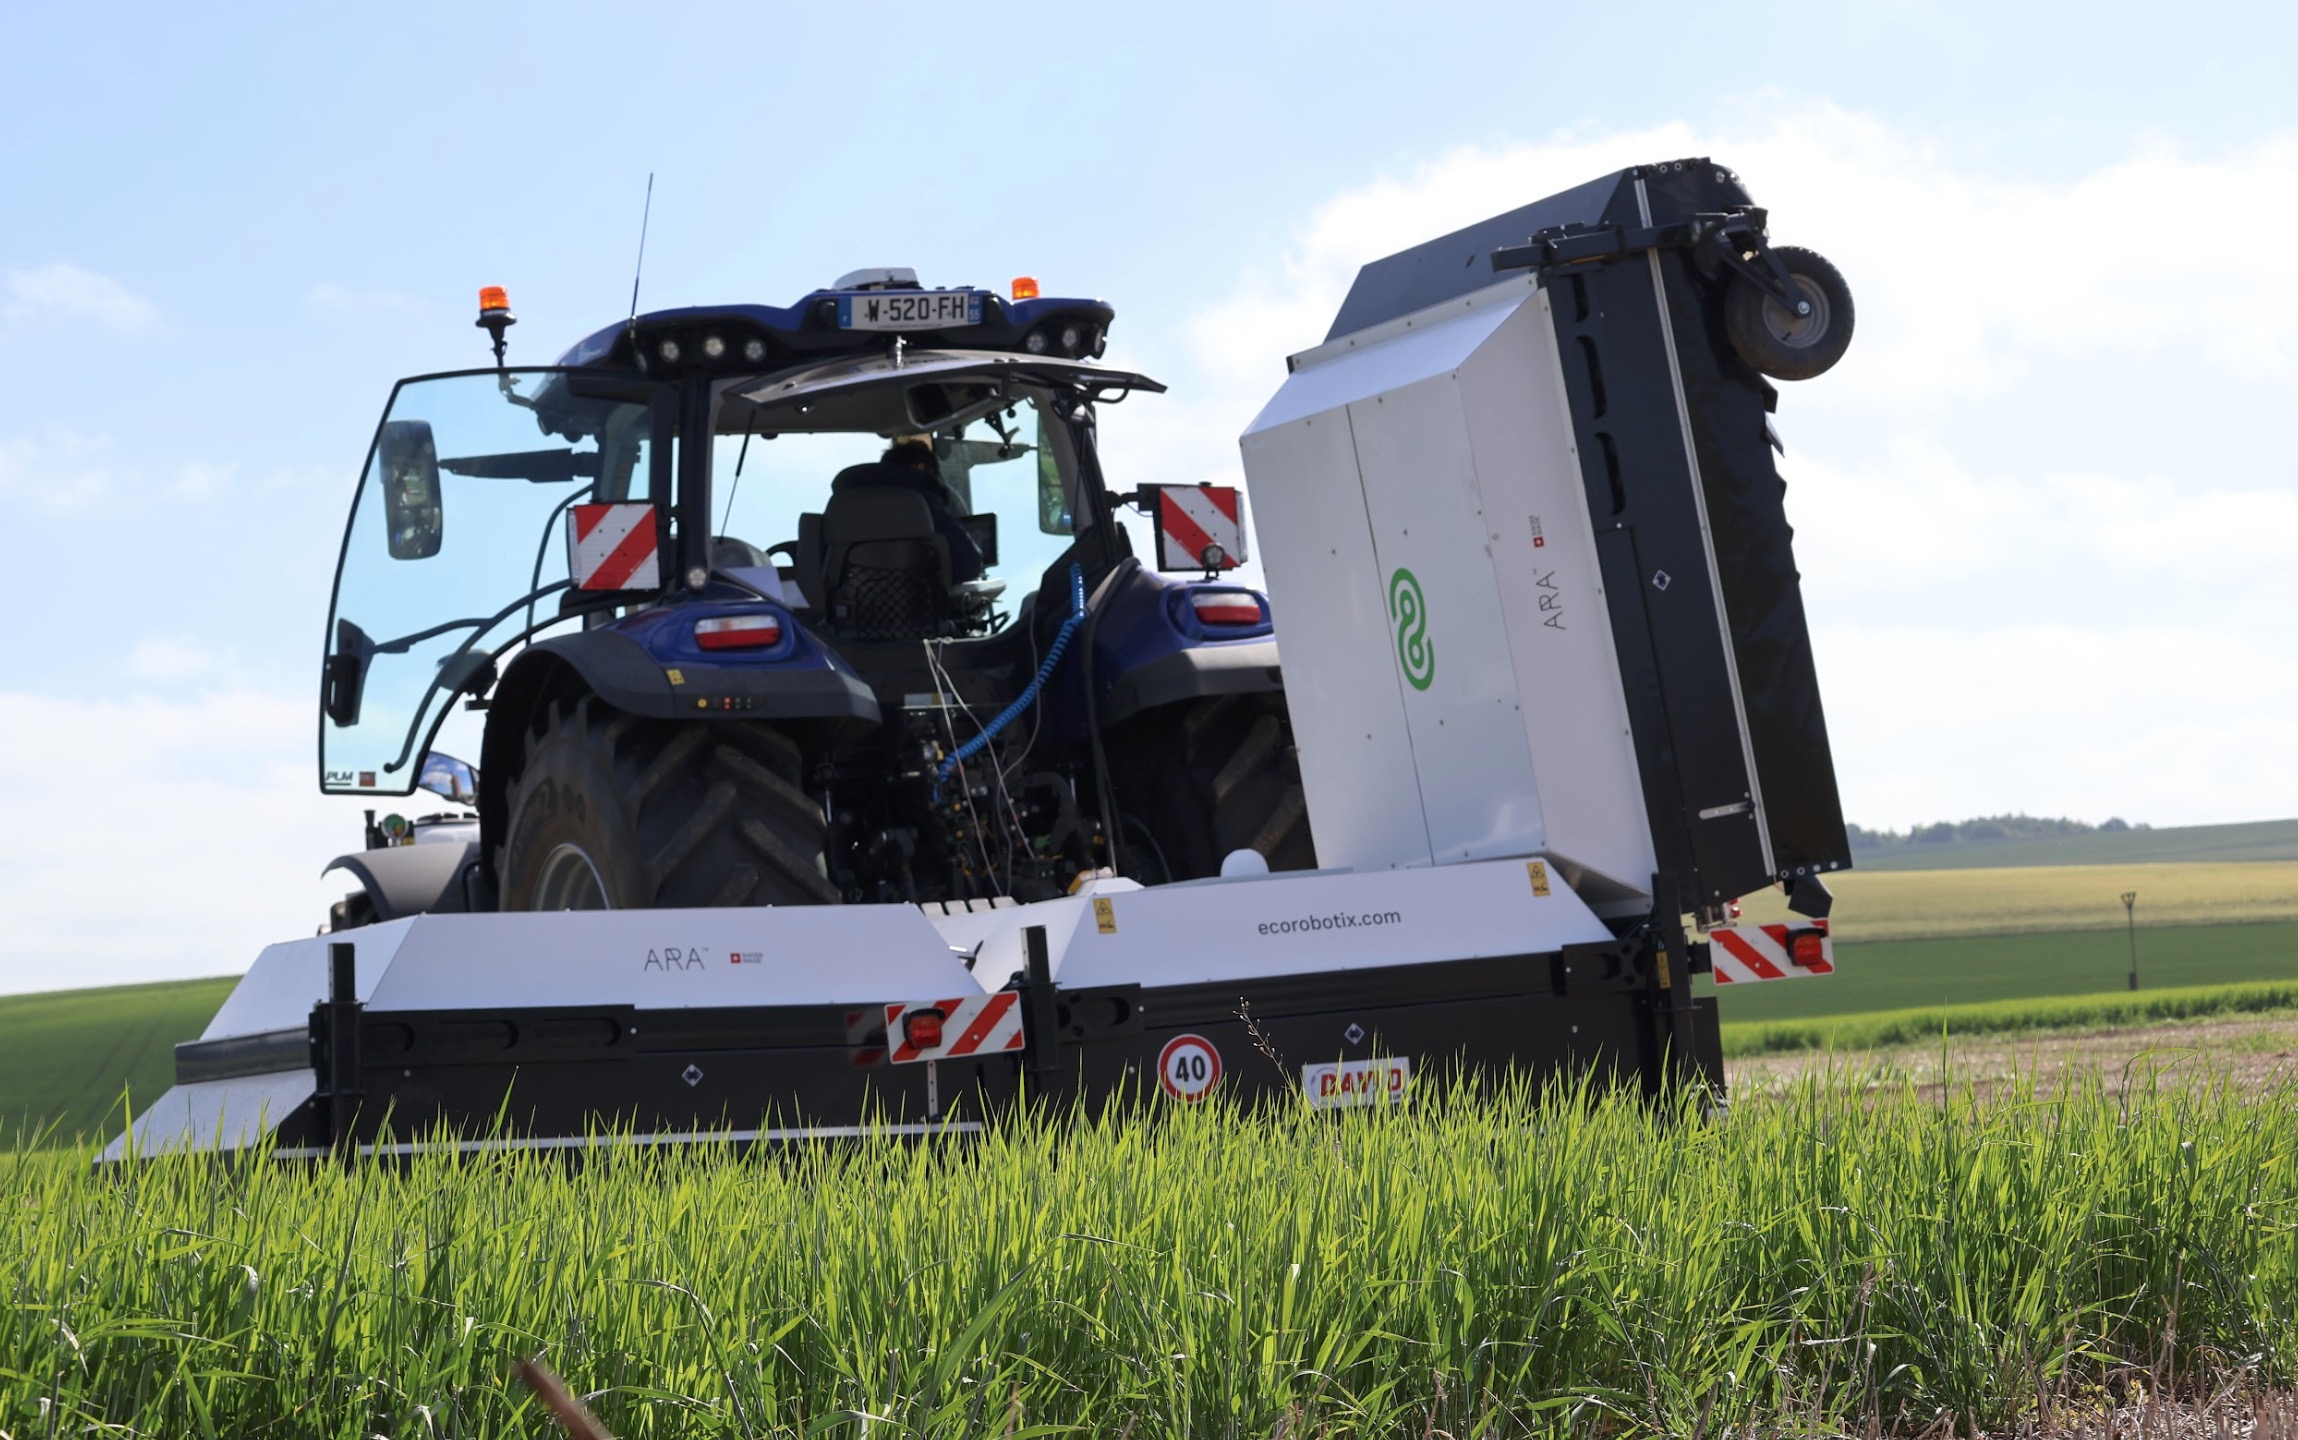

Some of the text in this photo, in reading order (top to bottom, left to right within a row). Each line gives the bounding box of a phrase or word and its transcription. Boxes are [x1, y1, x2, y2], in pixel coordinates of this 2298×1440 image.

[326, 771, 353, 781] PLM
[1258, 911, 1401, 935] ecorobotix.com
[1176, 1055, 1206, 1082] 40
